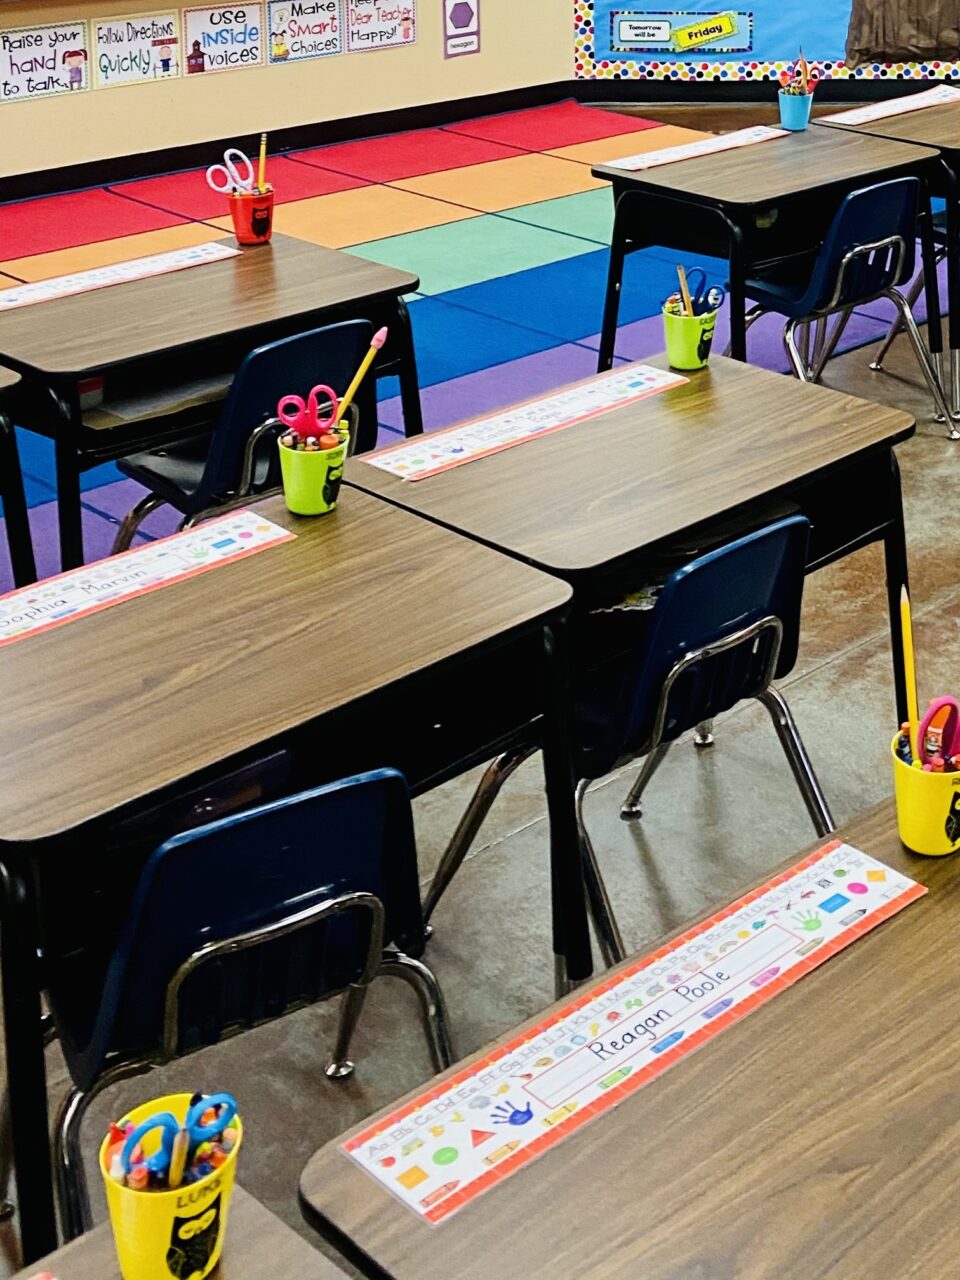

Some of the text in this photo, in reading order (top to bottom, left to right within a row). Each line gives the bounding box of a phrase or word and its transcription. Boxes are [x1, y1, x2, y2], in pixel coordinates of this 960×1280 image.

[291, 1, 336, 17] Make
[351, 9, 373, 26] Dear
[98, 27, 124, 45] Follow
[351, 25, 396, 43] Happy!
[688, 24, 722, 41] Friday
[1, 31, 80, 53] Raise your
[99, 49, 150, 79] Quickly
[3, 81, 19, 96] to
[80, 569, 148, 595] Marvin
[587, 970, 730, 1061] Reagan Poole
